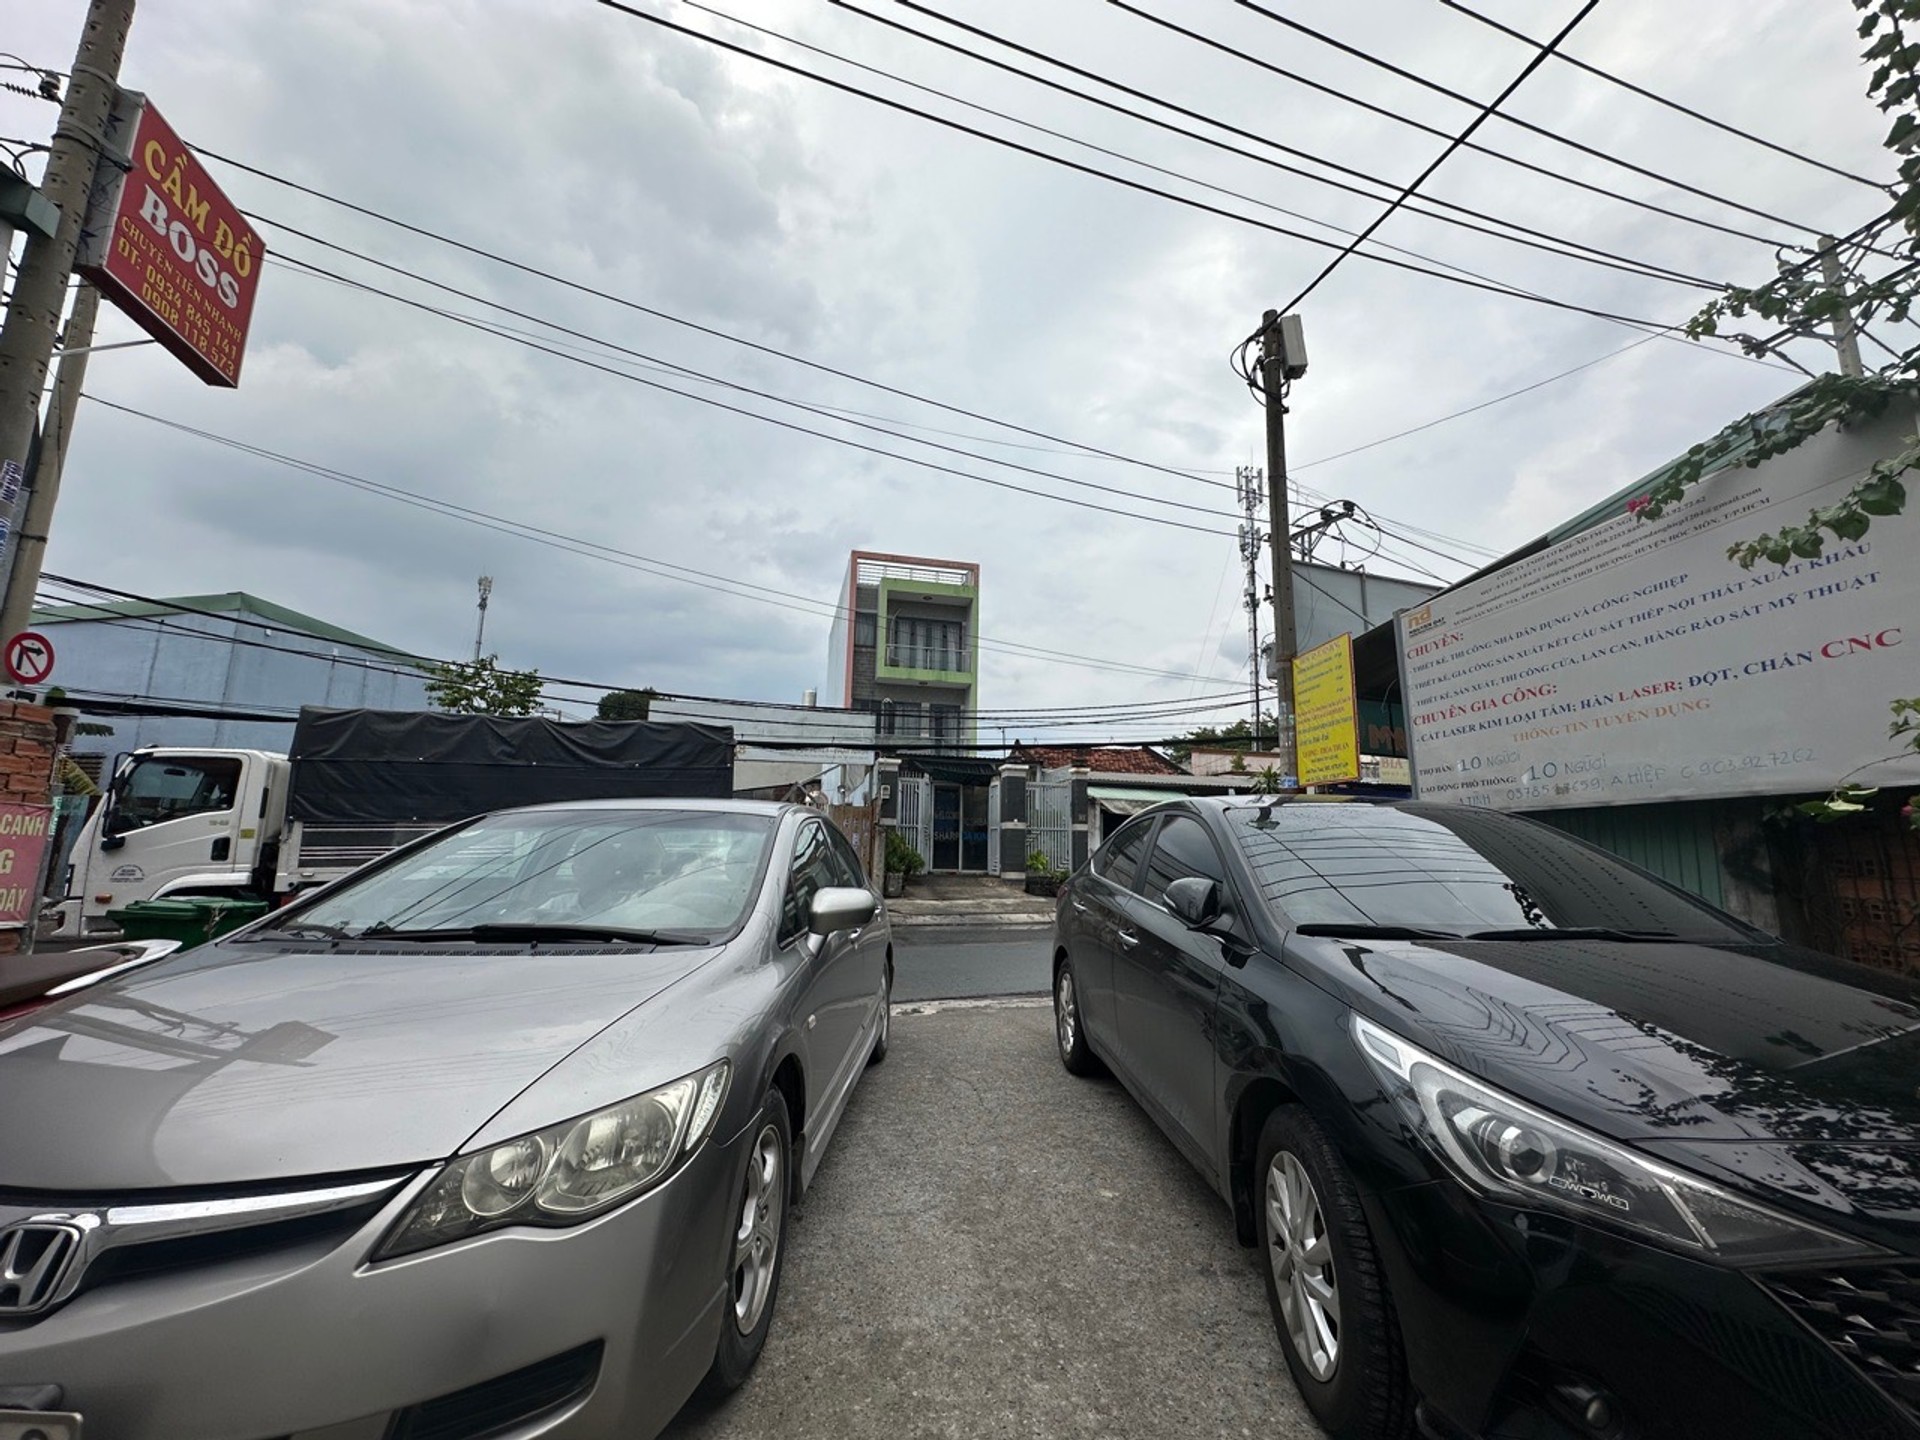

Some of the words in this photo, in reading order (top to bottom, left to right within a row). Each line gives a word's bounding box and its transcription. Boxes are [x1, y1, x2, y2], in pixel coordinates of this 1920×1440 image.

[139, 183, 240, 309] BOSS
[144, 140, 211, 234] CẦM
[213, 221, 251, 278] ĐỒ
[142, 282, 179, 327] 0908
[183, 321, 207, 351] 118
[211, 348, 235, 376] 573
[146, 267, 182, 307] 0934
[186, 303, 211, 335] 845
[215, 329, 237, 358] 141
[203, 296, 242, 342] NHANH
[1406, 629, 1463, 660] CHUYÊN:
[1450, 650, 1464, 660] THI
[1465, 639, 1491, 655] CÔNG
[1516, 623, 1536, 638] DÂN
[1539, 613, 1570, 632] DỤNG
[1573, 605, 1589, 619] VÀ
[1592, 591, 1629, 613] CÔNG
[1633, 571, 1688, 601] NGHIỆP
[1451, 668, 1466, 678] GIA
[1468, 658, 1494, 673] CÔNG
[1516, 643, 1544, 659] XUẤT
[1547, 635, 1568, 649] KẾT
[1571, 625, 1596, 642] CẤU
[1628, 604, 1664, 624] THÉP
[1668, 595, 1696, 614] NỘI
[1699, 578, 1746, 603] THẤT
[1750, 560, 1804, 588] XUẤT
[1808, 539, 1872, 570] KHẨU
[1471, 677, 1498, 692] XUẤT,
[1500, 672, 1517, 683] THI
[1519, 662, 1549, 678] CÔNG
[1550, 653, 1579, 670] CỬA,
[1581, 647, 1606, 661] LAN
[1609, 637, 1641, 654] CAN,
[1644, 623, 1686, 644] HÀNG
[1690, 611, 1725, 631] RÀO
[1768, 591, 1798, 611] MỸ
[1803, 569, 1881, 603] THUẬT
[1412, 703, 1466, 726] CHUYÊN
[1470, 696, 1497, 712] GIA
[1501, 679, 1557, 704] CÔNG:
[1420, 729, 1440, 742] CẮT
[1442, 723, 1475, 737] LASER
[1478, 717, 1501, 730] KIM
[1505, 709, 1536, 726] LOẠI
[1539, 700, 1576, 717] TẤM;
[1579, 691, 1613, 709] HÀN
[1617, 677, 1683, 702] LASER;
[1688, 664, 1738, 688] ĐỘT,
[1742, 646, 1813, 676] CHẤN
[1820, 625, 1903, 660] CNC
[1512, 724, 1559, 742] THÔNG
[1562, 719, 1588, 733] TIN
[1591, 706, 1649, 728] TUYỂN
[1654, 696, 1710, 719] DỤNG
[1381, 757, 1404, 769] BIA
[1420, 785, 1435, 793] LAO
[1436, 782, 1459, 792] ĐỘNG
[1480, 774, 1516, 786] THÔNG:
[1528, 761, 1557, 781] 10
[1459, 755, 1482, 771] 10
